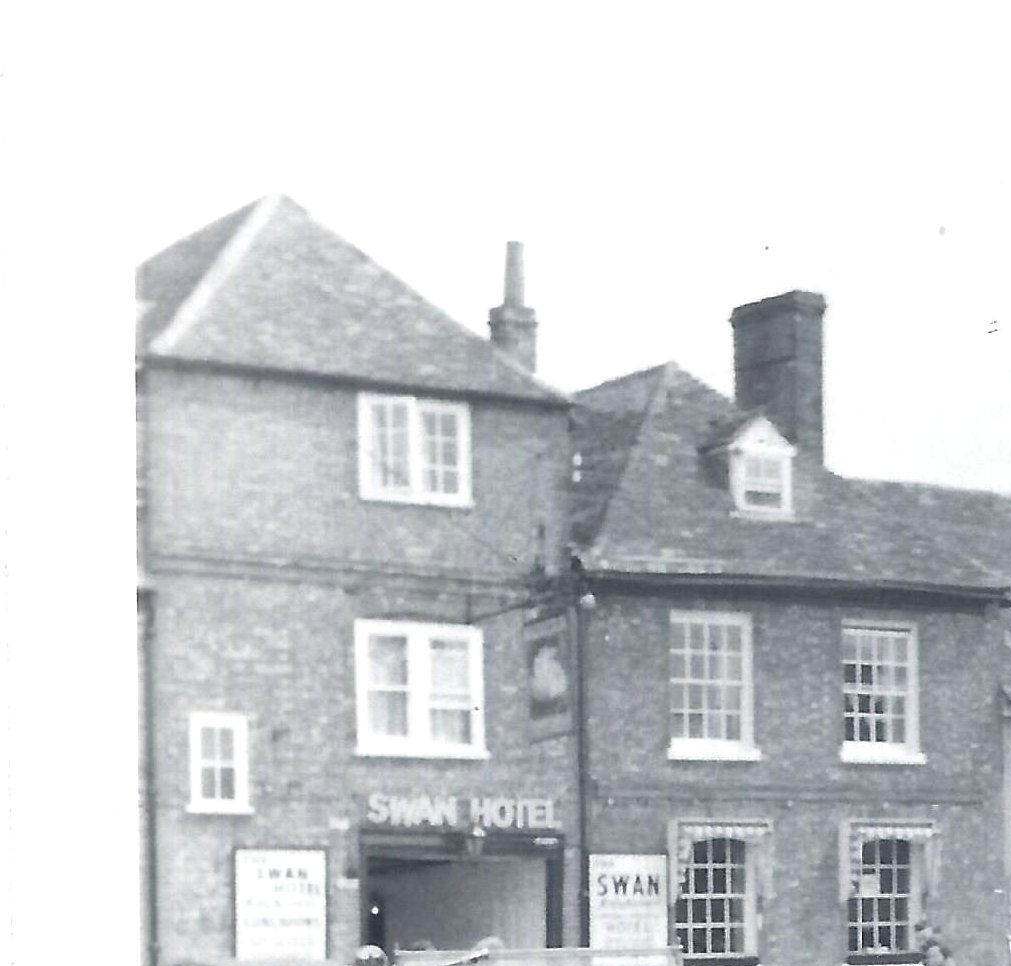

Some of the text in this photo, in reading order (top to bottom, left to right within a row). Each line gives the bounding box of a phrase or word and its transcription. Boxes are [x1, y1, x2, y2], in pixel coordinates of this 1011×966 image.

[368, 794, 562, 828] SWAN HOTEL
[597, 872, 660, 897] SWAN
